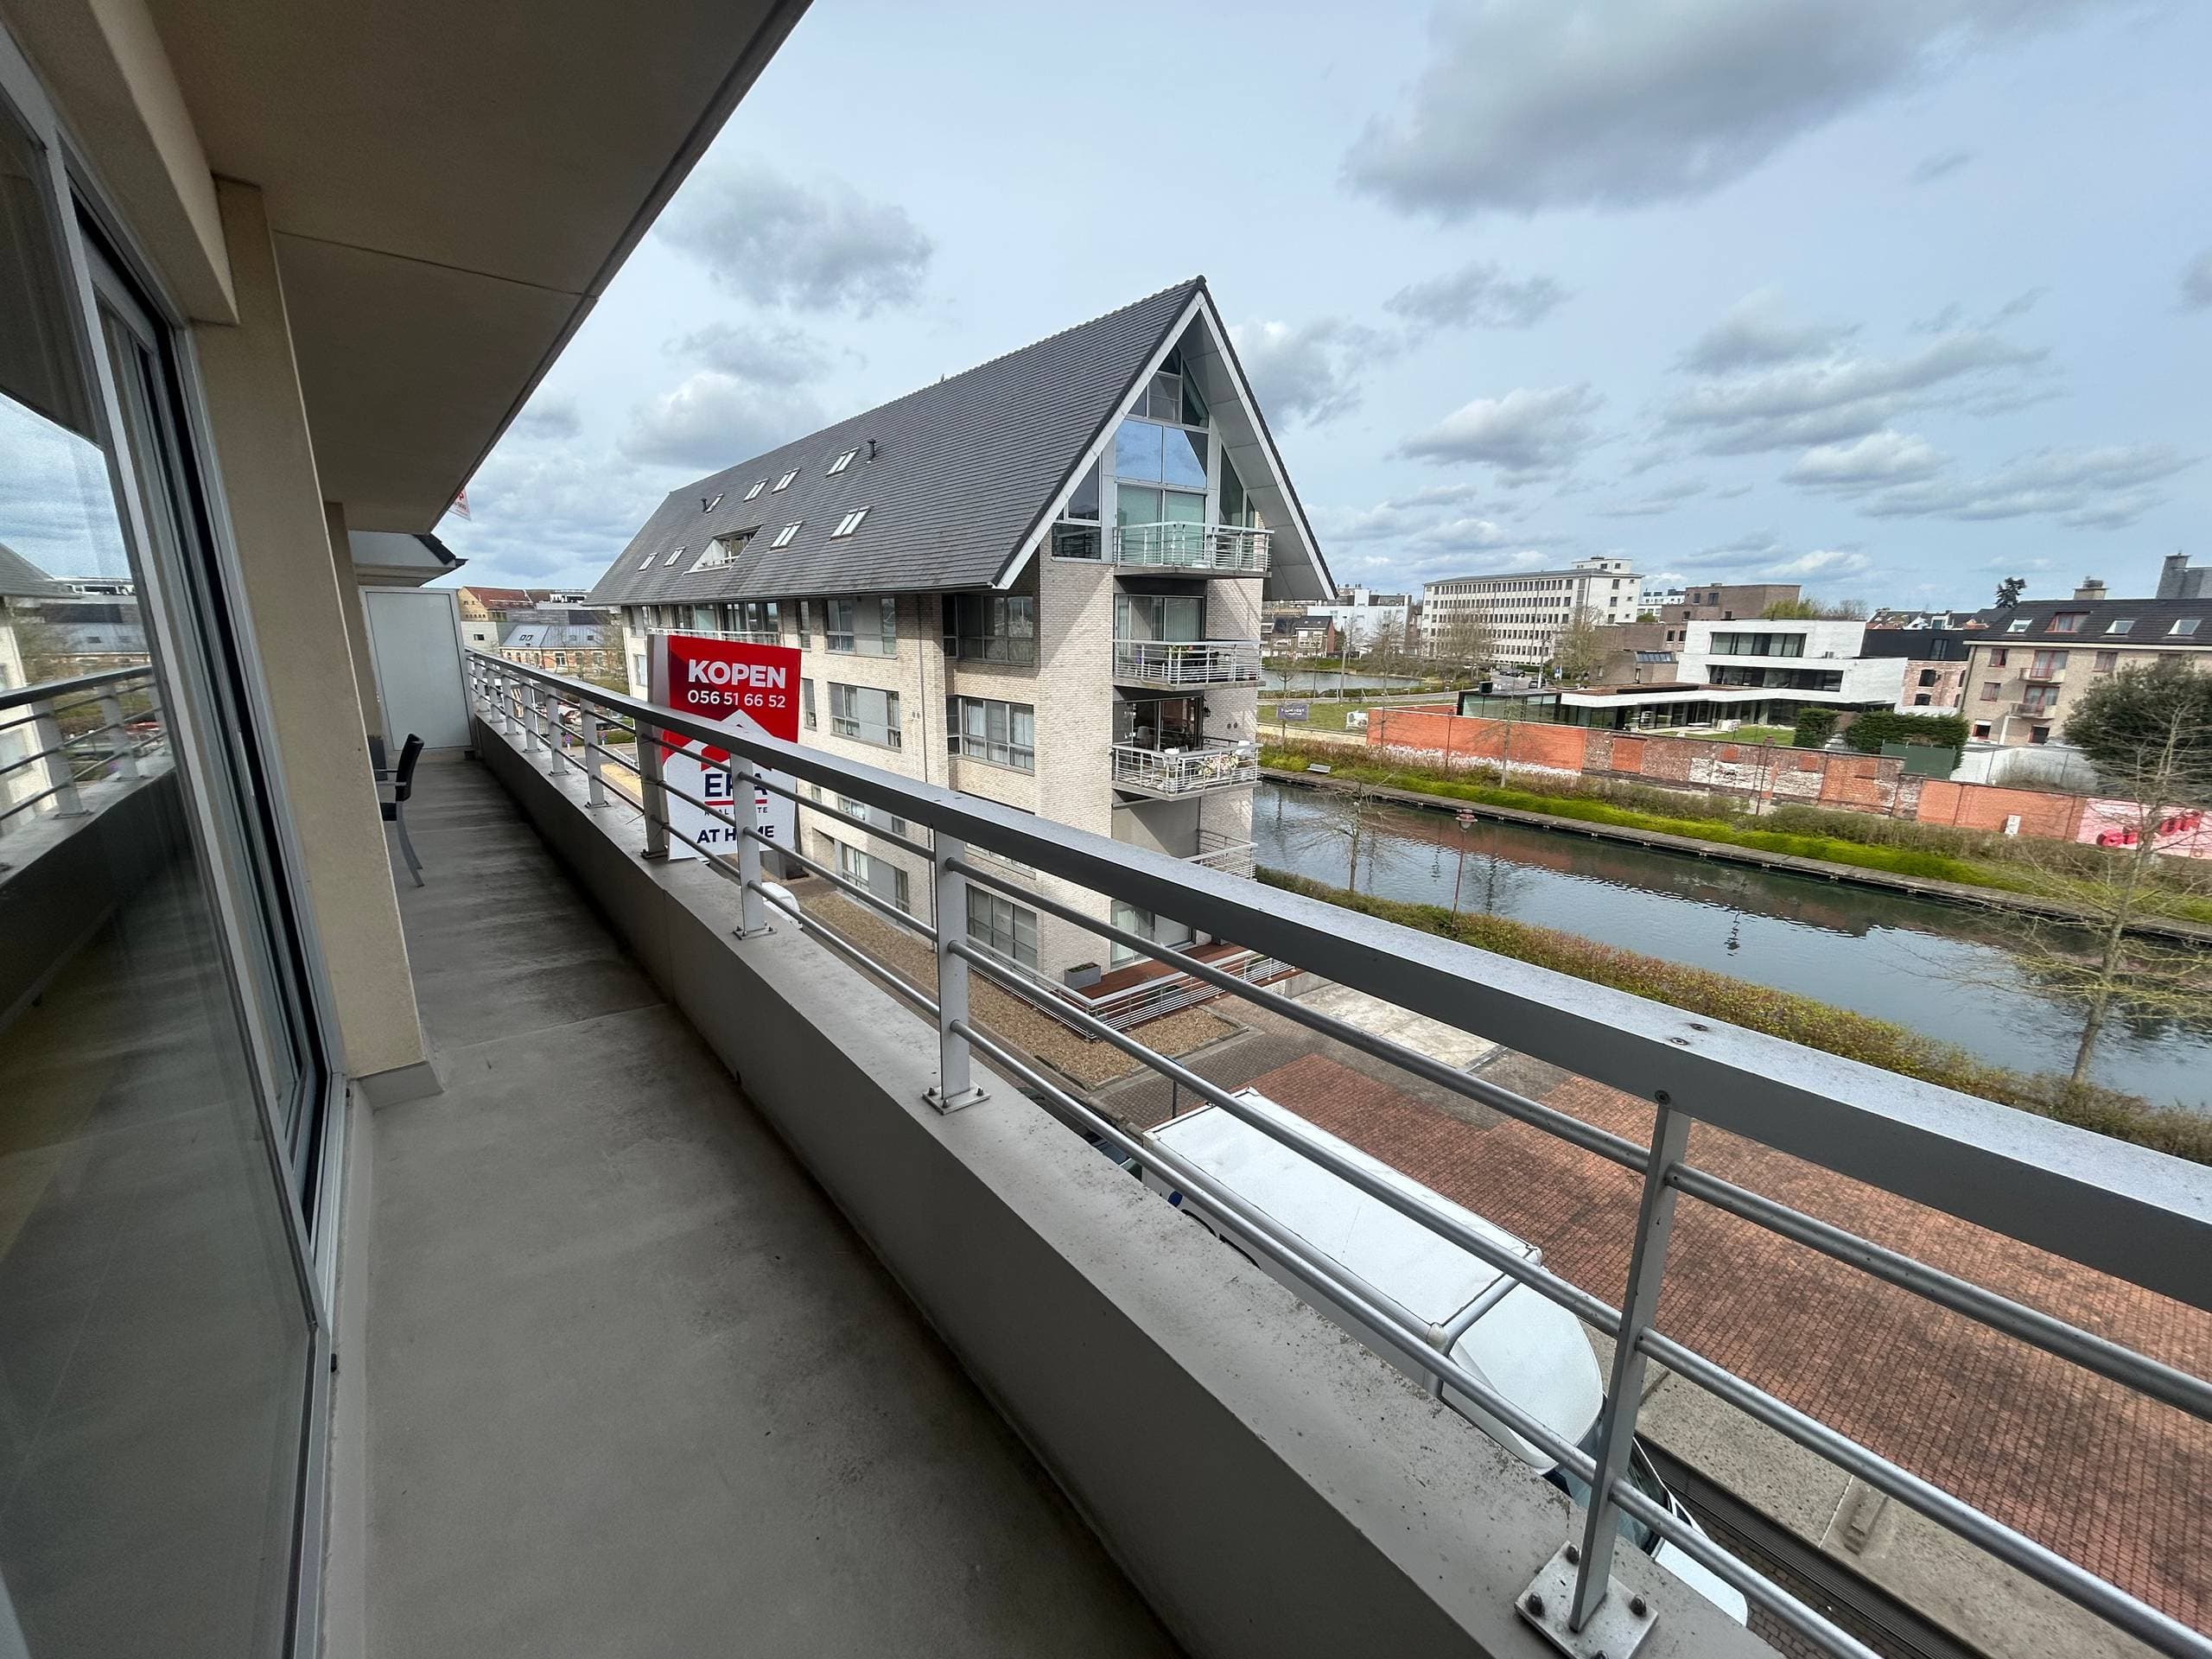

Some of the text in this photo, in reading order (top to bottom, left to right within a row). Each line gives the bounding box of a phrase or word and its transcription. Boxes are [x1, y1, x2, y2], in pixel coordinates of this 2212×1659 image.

[688, 658, 785, 689] KOPEN
[688, 690, 785, 709] 056 51 66 52
[696, 829, 721, 843] AT
